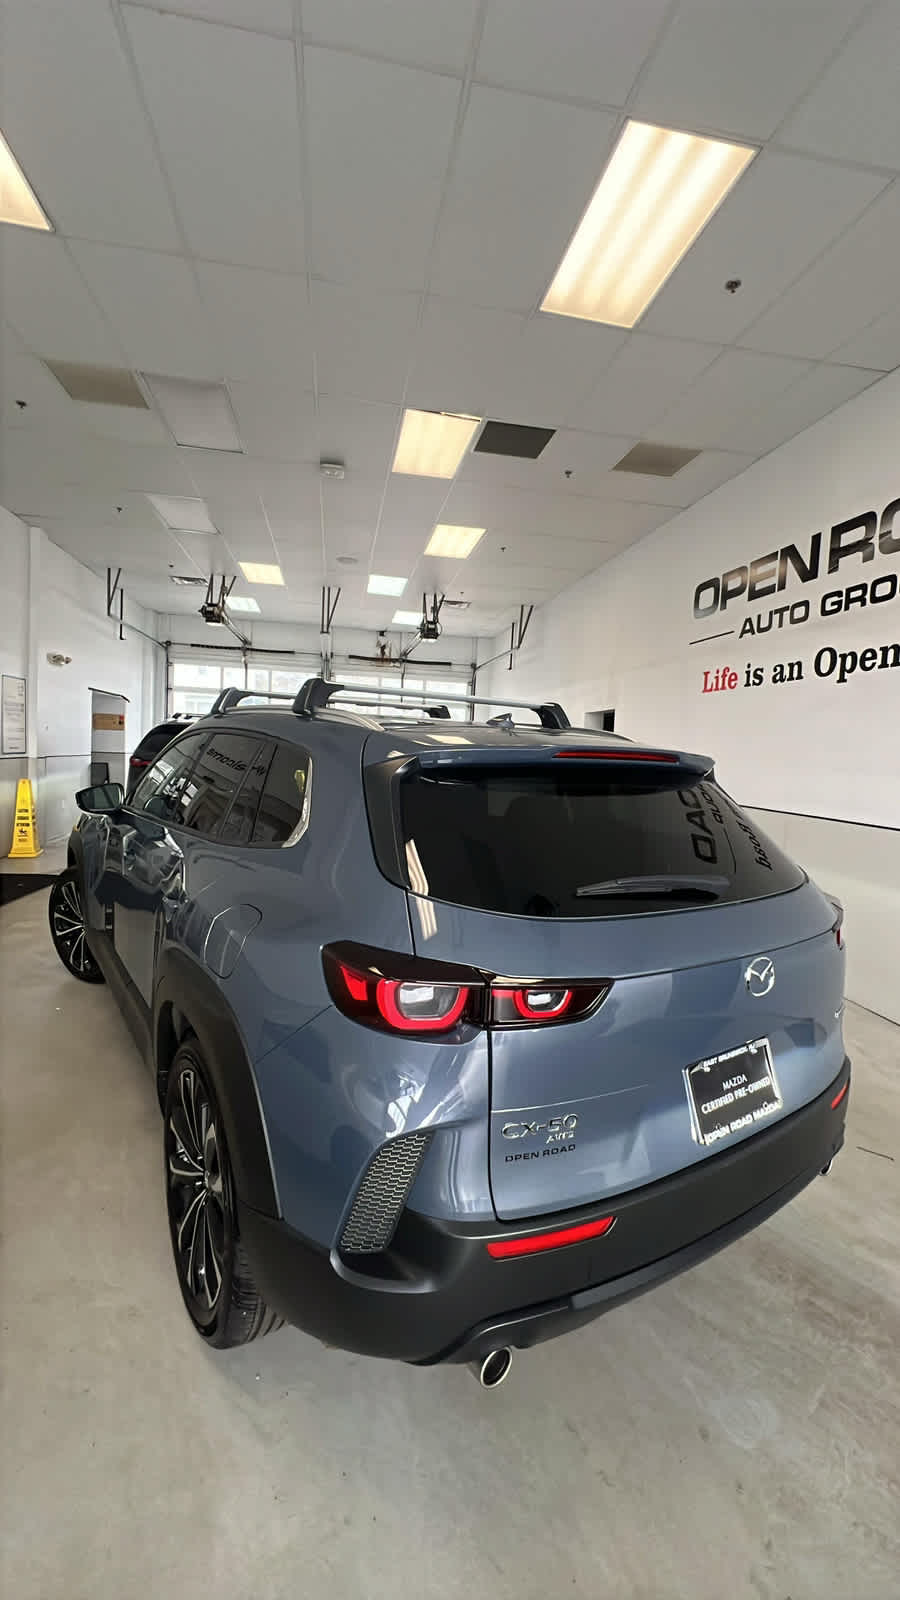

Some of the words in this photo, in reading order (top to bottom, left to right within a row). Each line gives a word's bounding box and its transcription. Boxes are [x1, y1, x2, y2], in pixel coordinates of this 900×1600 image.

[693, 531, 822, 620] OPEN
[738, 599, 810, 639] AUTO
[820, 573, 900, 617] GRO
[701, 666, 738, 693] Life
[744, 663, 764, 688] is
[772, 660, 804, 684] an
[814, 643, 900, 683] Open
[701, 1092, 735, 1114] CERTIFIED
[734, 1076, 771, 1100] PRE-OWNED
[722, 1074, 748, 1091] MAZDA
[501, 1113, 578, 1140] CX-50
[729, 1113, 753, 1133] ROAD
[505, 1152, 540, 1162] OPEN
[542, 1144, 576, 1157] ROAD
